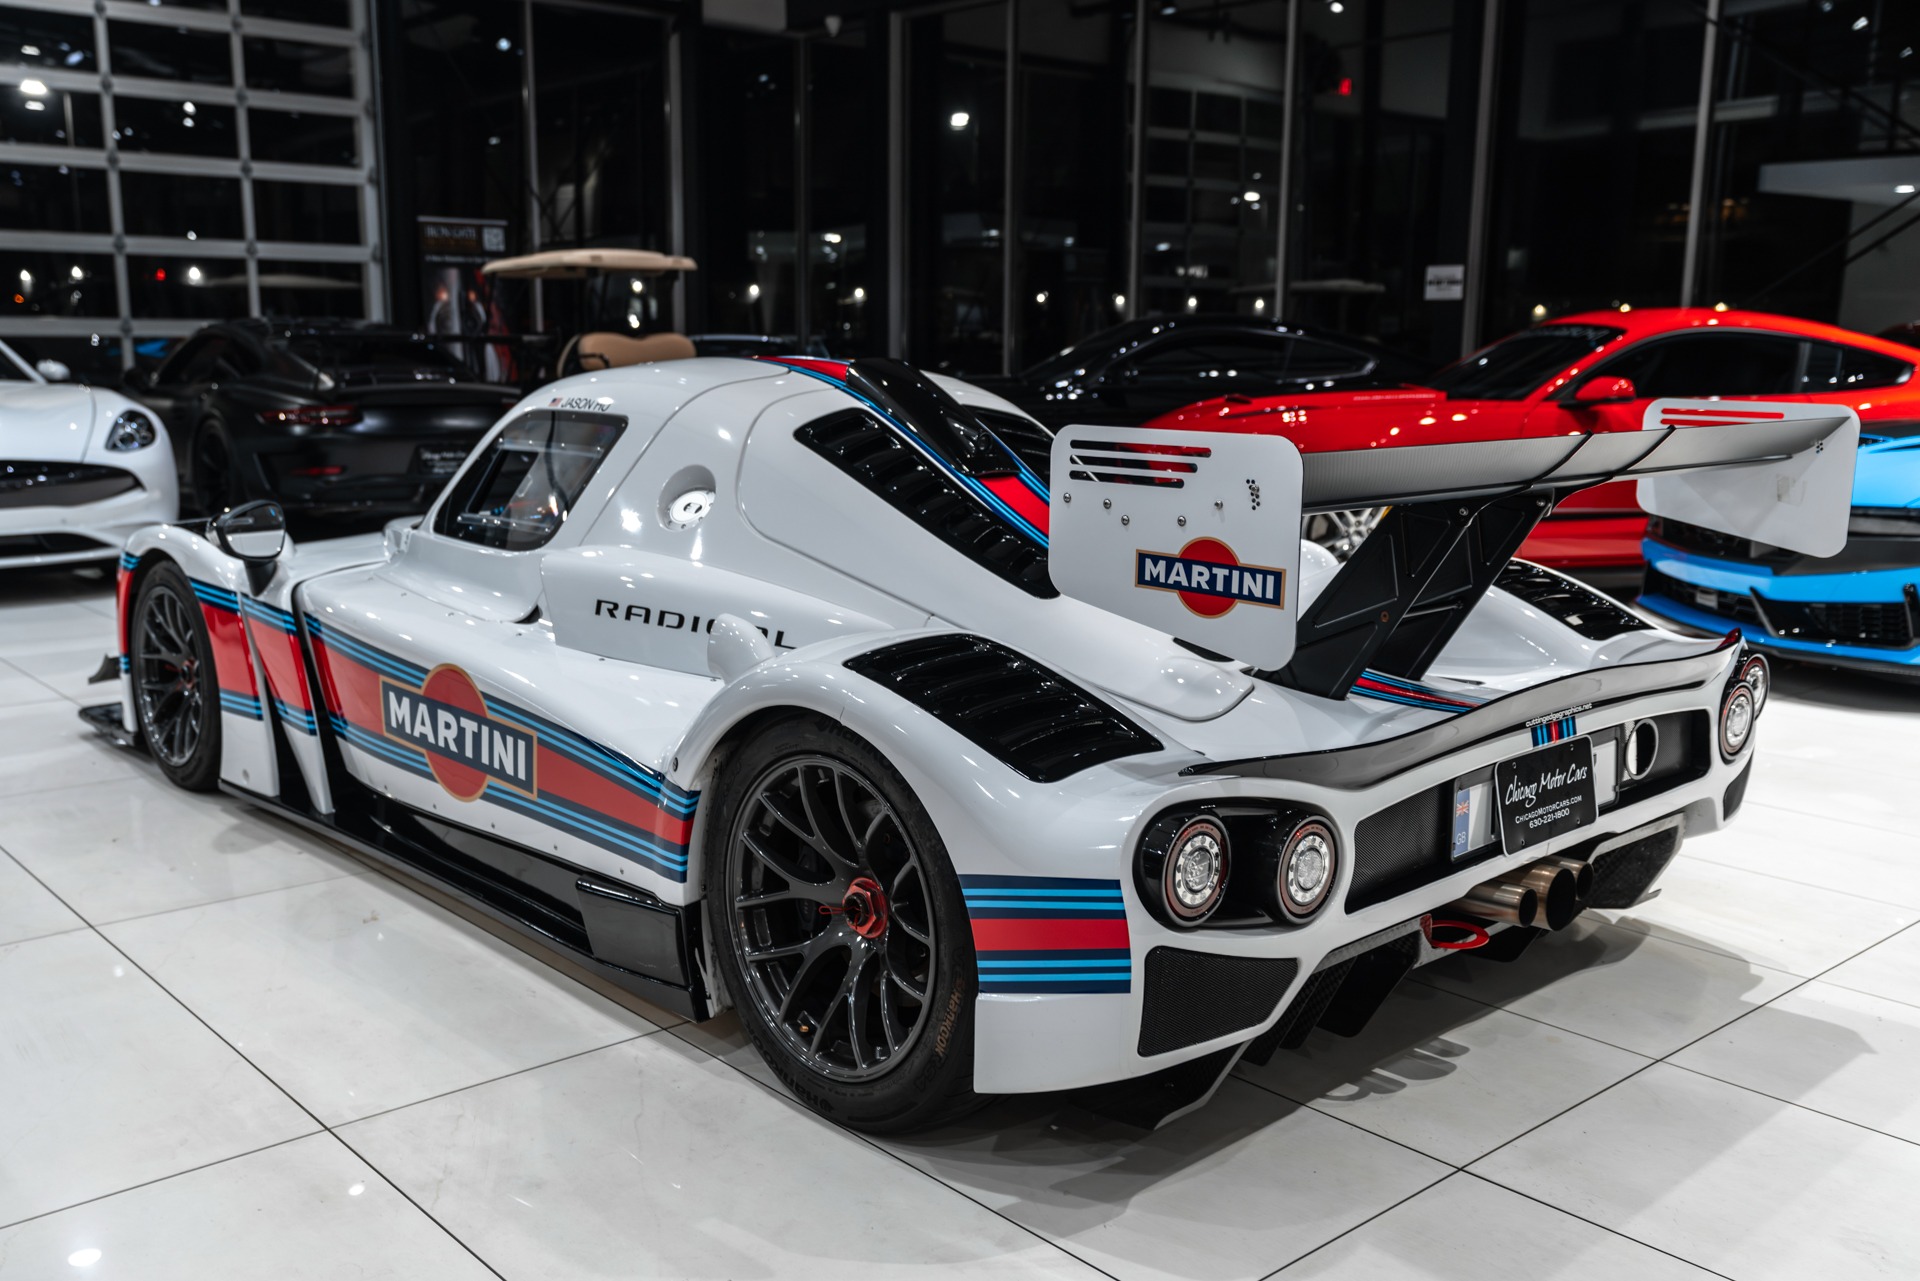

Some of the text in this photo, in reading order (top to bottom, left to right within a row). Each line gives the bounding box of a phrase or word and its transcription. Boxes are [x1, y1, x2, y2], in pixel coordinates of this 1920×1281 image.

[561, 397, 593, 410] JASON
[1144, 557, 1275, 600] MARTINI
[595, 599, 797, 650] RADIL
[1525, 702, 1593, 727] cuttingedgegraphics.net
[388, 691, 527, 782] MARTINI
[1505, 763, 1588, 808] Chicago Motor Cars
[1456, 831, 1467, 846] GB
[1529, 808, 1570, 829] 630-221-1800
[935, 990, 962, 1057] Hankook
